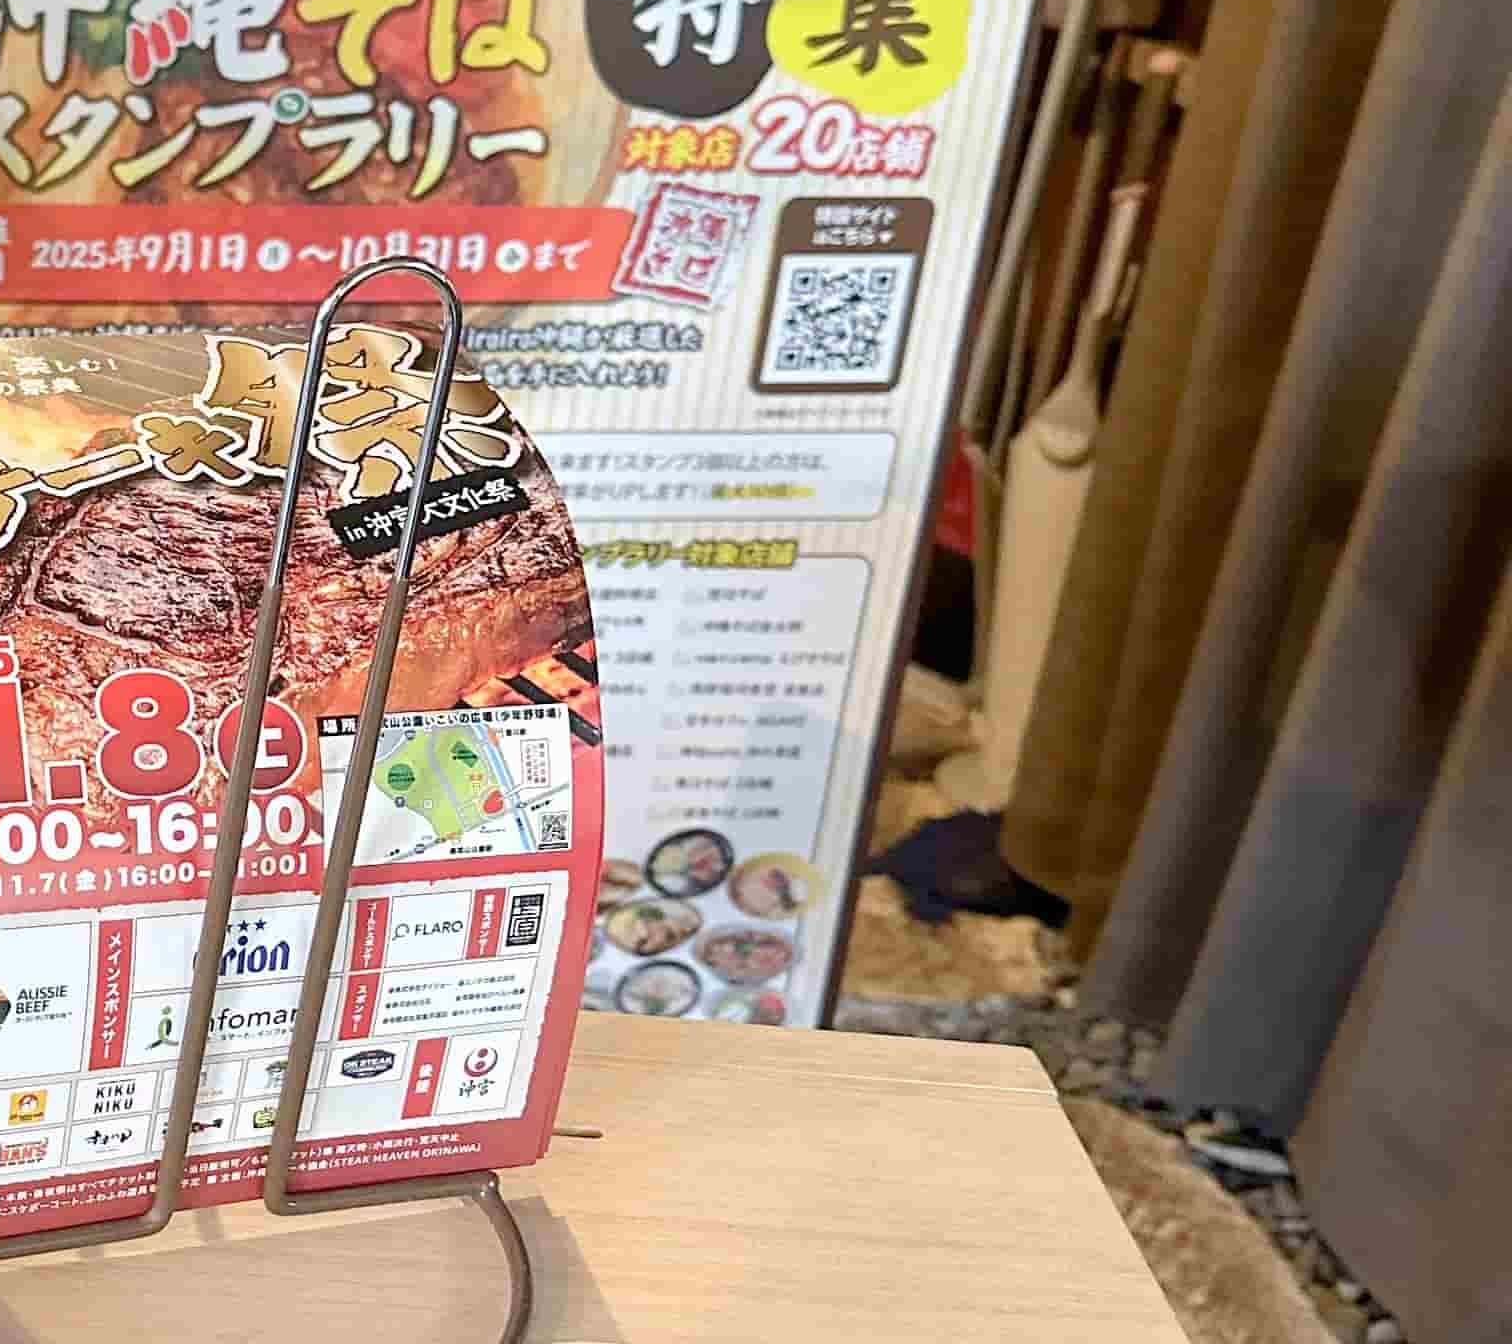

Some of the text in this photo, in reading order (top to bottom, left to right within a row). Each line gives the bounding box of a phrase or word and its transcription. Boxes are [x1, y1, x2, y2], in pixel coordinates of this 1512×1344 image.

[344, 525, 368, 544] in
[15, 1000, 50, 1015] BEEF
[96, 1081, 137, 1100] KIKU
[94, 1097, 135, 1115] NIKU
